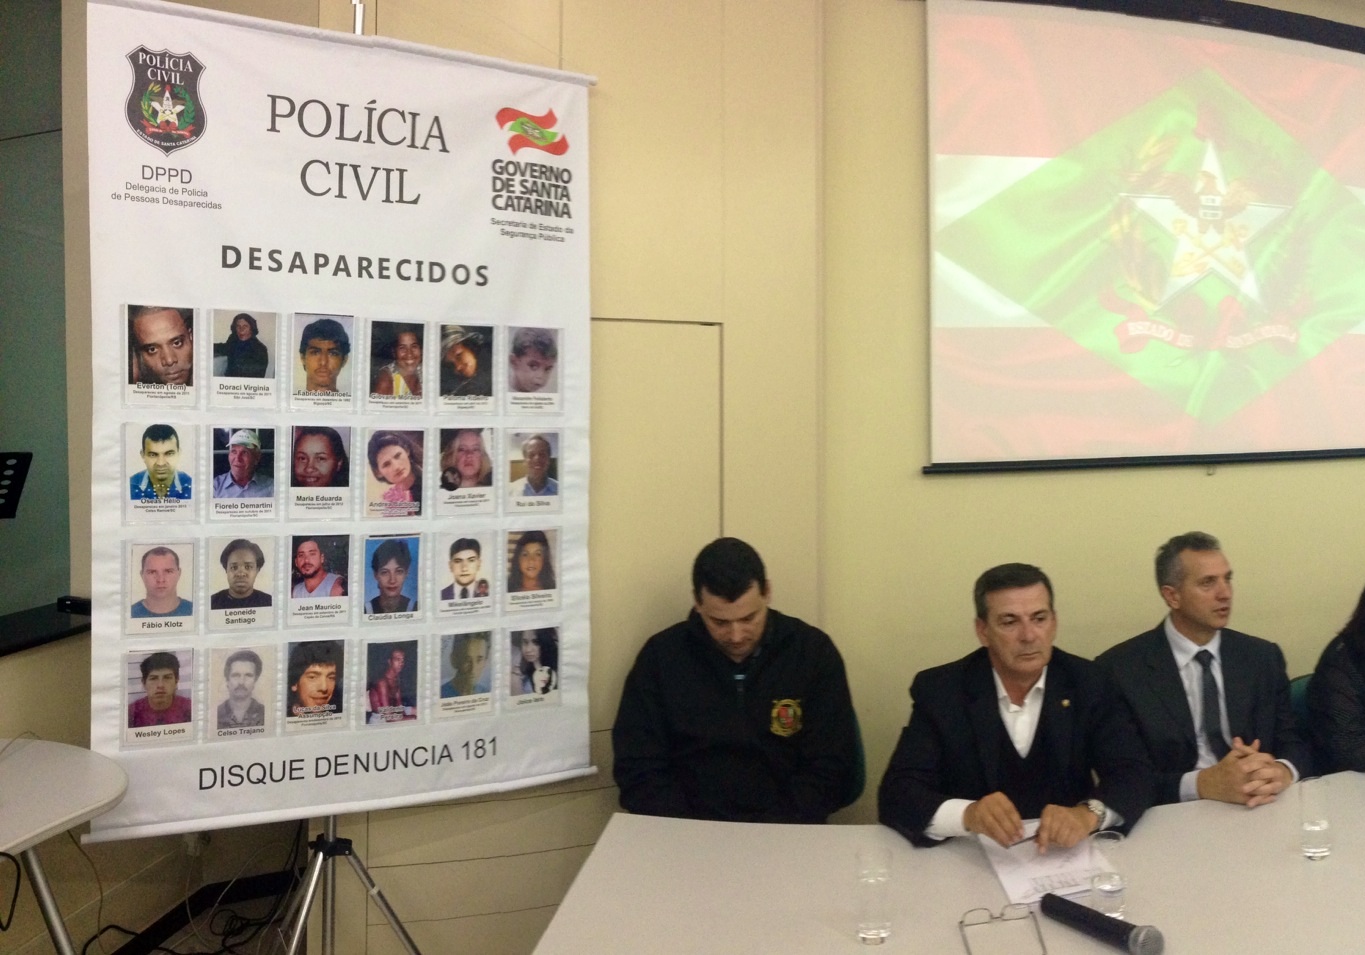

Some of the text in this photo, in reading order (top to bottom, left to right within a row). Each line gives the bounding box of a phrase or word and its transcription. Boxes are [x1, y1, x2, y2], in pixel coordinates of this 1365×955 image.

[138, 52, 193, 72] POLÍCIA
[147, 68, 184, 85] CIVIL
[266, 94, 450, 153] POLÍCIA
[141, 164, 193, 185] DPPD
[491, 158, 572, 185] GOVERNO
[125, 181, 166, 195] Delegacia
[169, 186, 180, 195] de
[300, 159, 421, 205] CIVIL
[491, 176, 572, 202] DE SANTA
[111, 192, 222, 210] de Pessoas Desaparecidas
[491, 194, 572, 219] CATARINA
[221, 244, 490, 288] DESAPARECIDOS
[136, 382, 187, 392] Everton (Tom)
[244, 384, 270, 392] Virginia
[214, 502, 238, 510] Fiorelo
[224, 609, 256, 617] Leoneide
[298, 604, 314, 612] Jean
[225, 617, 256, 625] Santiago
[135, 728, 186, 738] Wesley Lopes
[217, 728, 265, 737] Celso Trajano
[199, 736, 498, 790] DISQUE DENUNCIA 181
